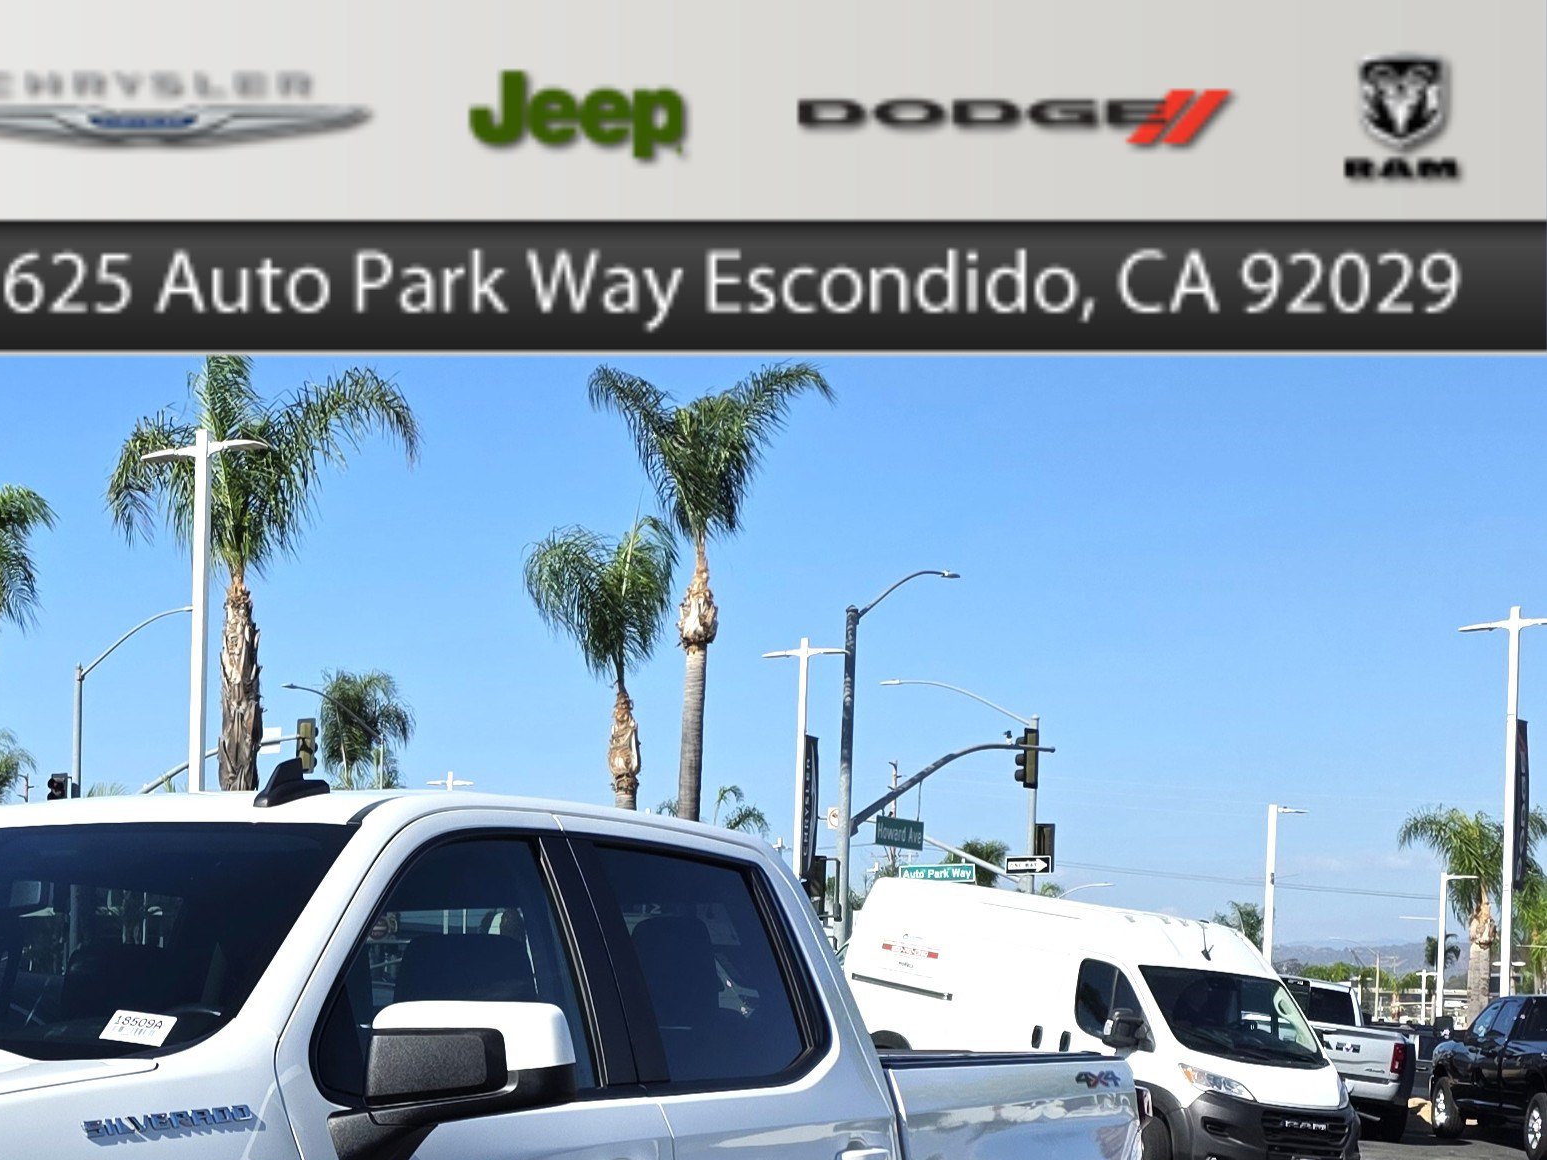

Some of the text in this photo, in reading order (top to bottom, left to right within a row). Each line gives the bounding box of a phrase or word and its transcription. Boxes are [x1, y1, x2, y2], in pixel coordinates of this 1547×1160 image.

[877, 821, 922, 845] Howard Ave
[902, 866, 972, 879] Auto Park Way
[114, 1015, 163, 1030] 18509A
[82, 1103, 253, 1139] SILVERADO
[1285, 1120, 1327, 1131] RAM
